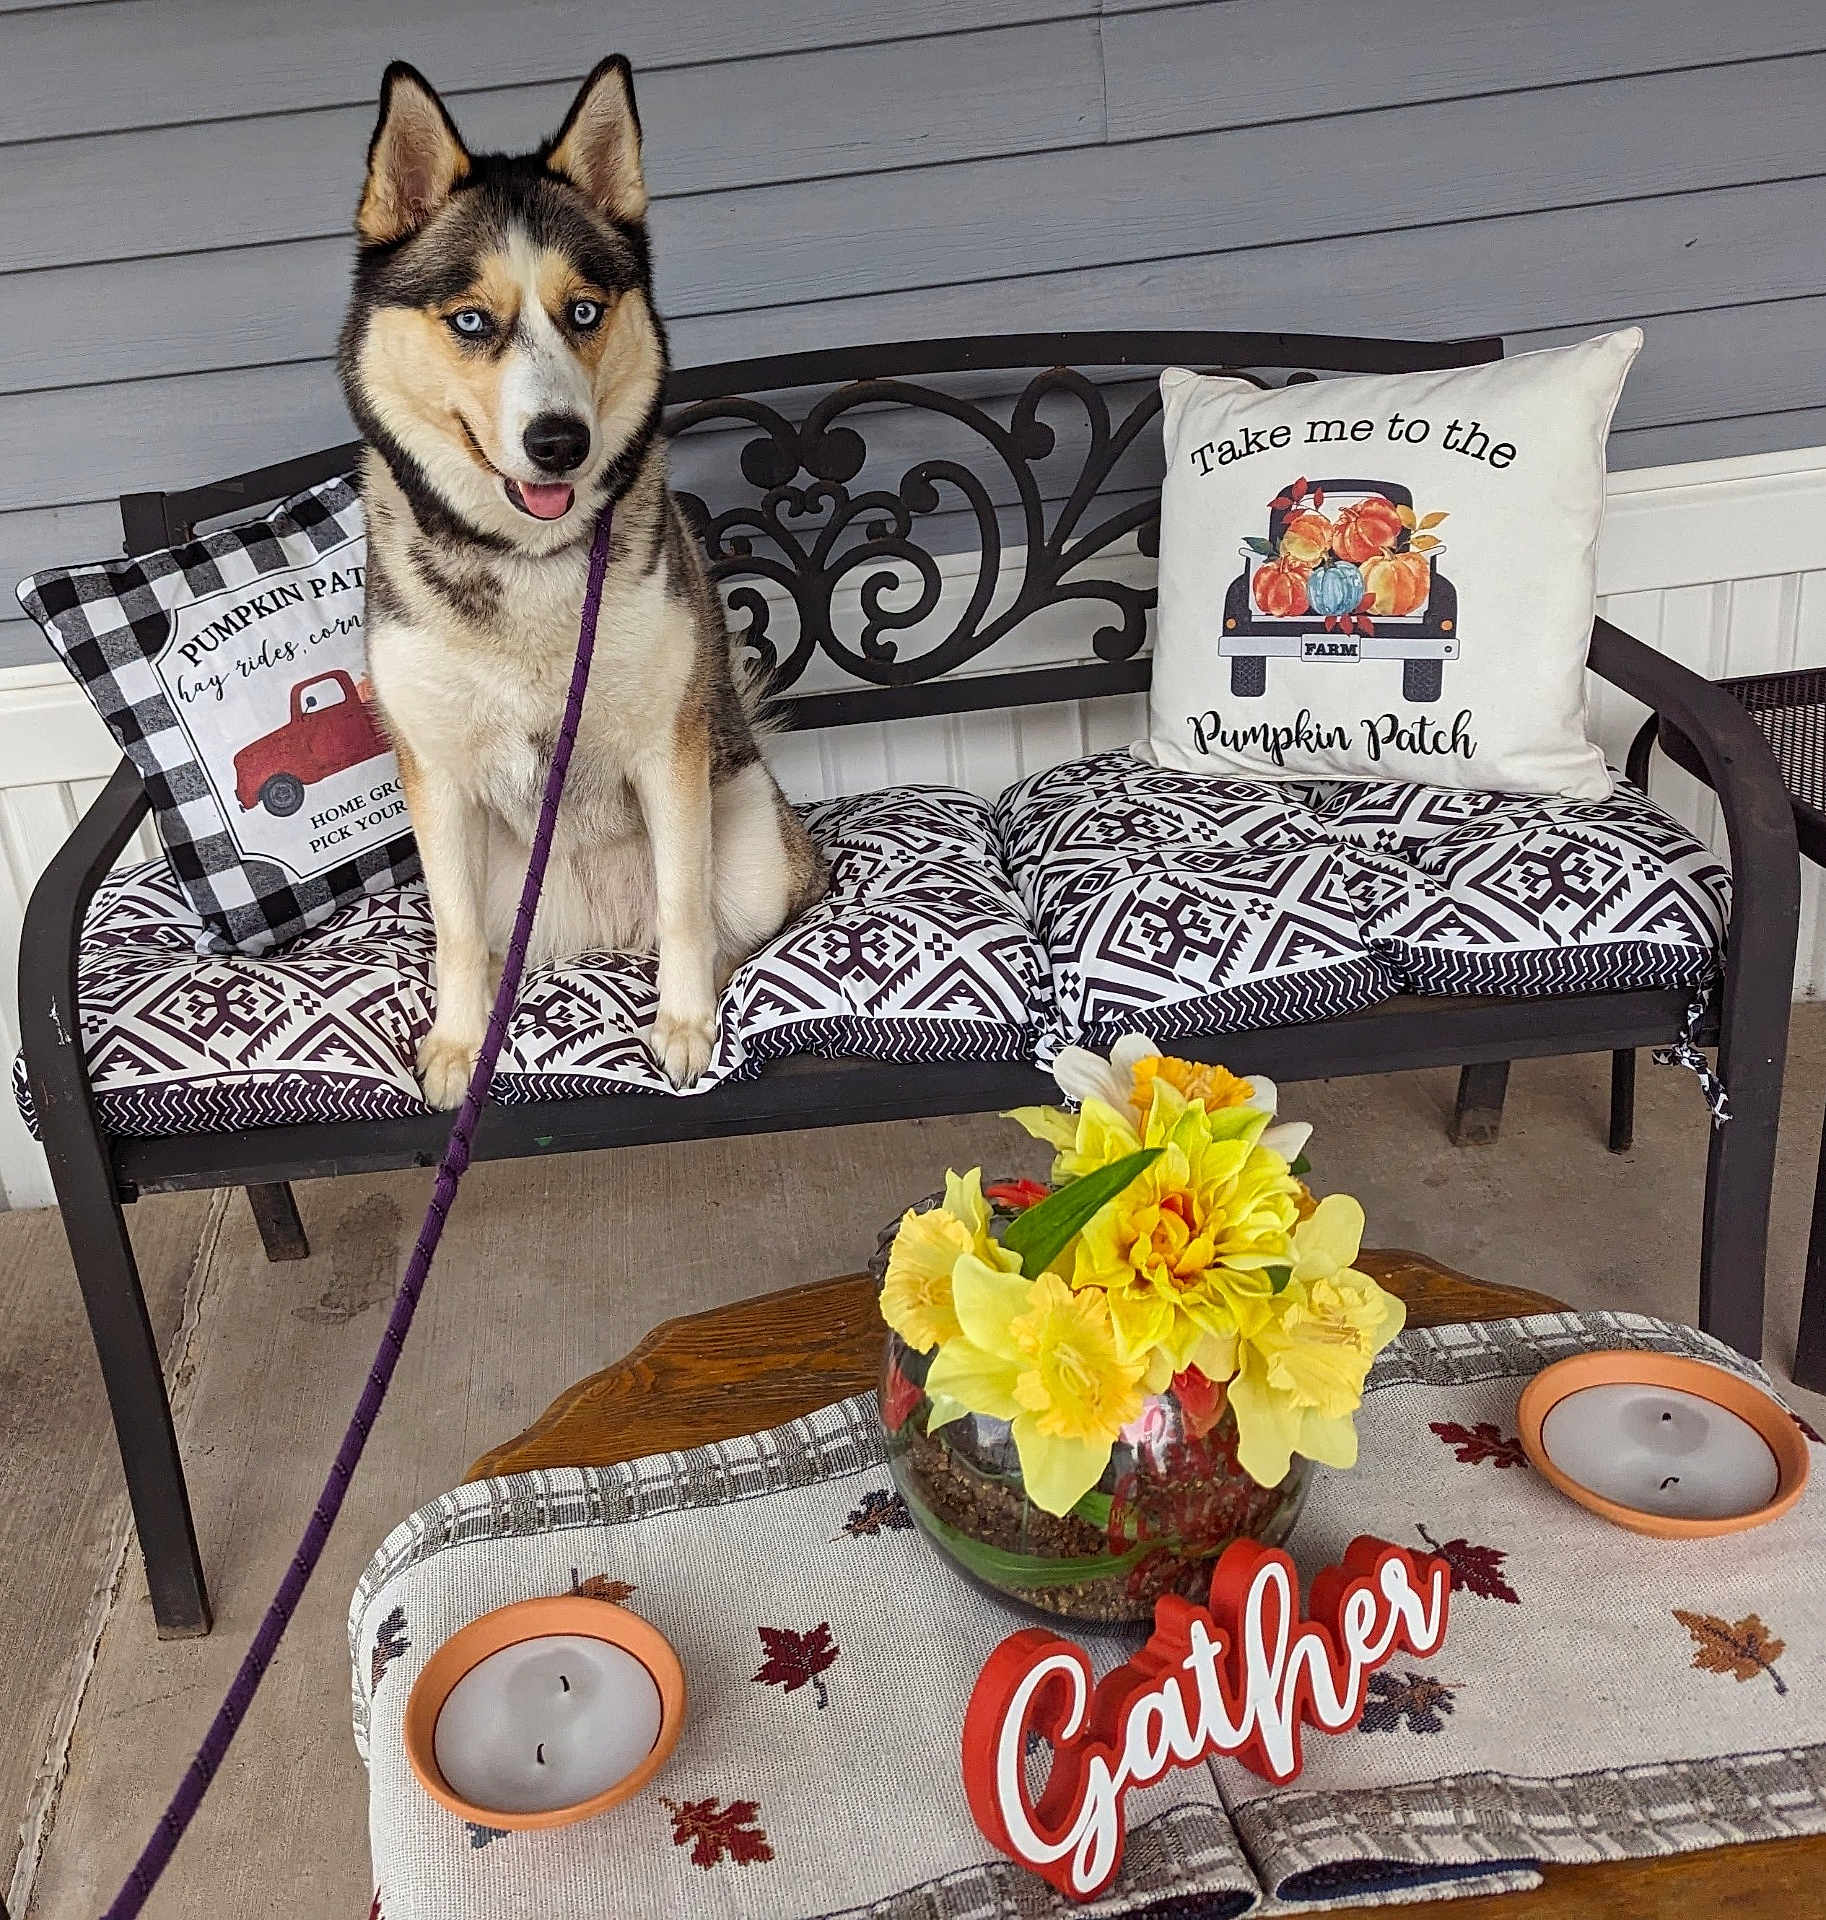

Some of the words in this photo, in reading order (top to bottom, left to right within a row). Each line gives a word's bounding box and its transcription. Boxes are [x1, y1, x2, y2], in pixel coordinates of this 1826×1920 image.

[1190, 424, 1291, 476] Take
[1303, 418, 1374, 443] me
[1387, 412, 1430, 442] to
[1442, 417, 1517, 468] the
[177, 582, 305, 667] PUMPKIN
[307, 567, 366, 599] PAT
[176, 672, 230, 702] hay
[235, 639, 308, 678] rides,
[309, 614, 363, 645] corn
[1304, 642, 1358, 656] FARM
[1187, 709, 1352, 766] Pumpkin
[1360, 709, 1478, 761] Patch
[309, 824, 353, 854] PICK
[354, 800, 408, 831] YOUR
[310, 795, 367, 830] HOME
[998, 1558, 1442, 1894] Gather
